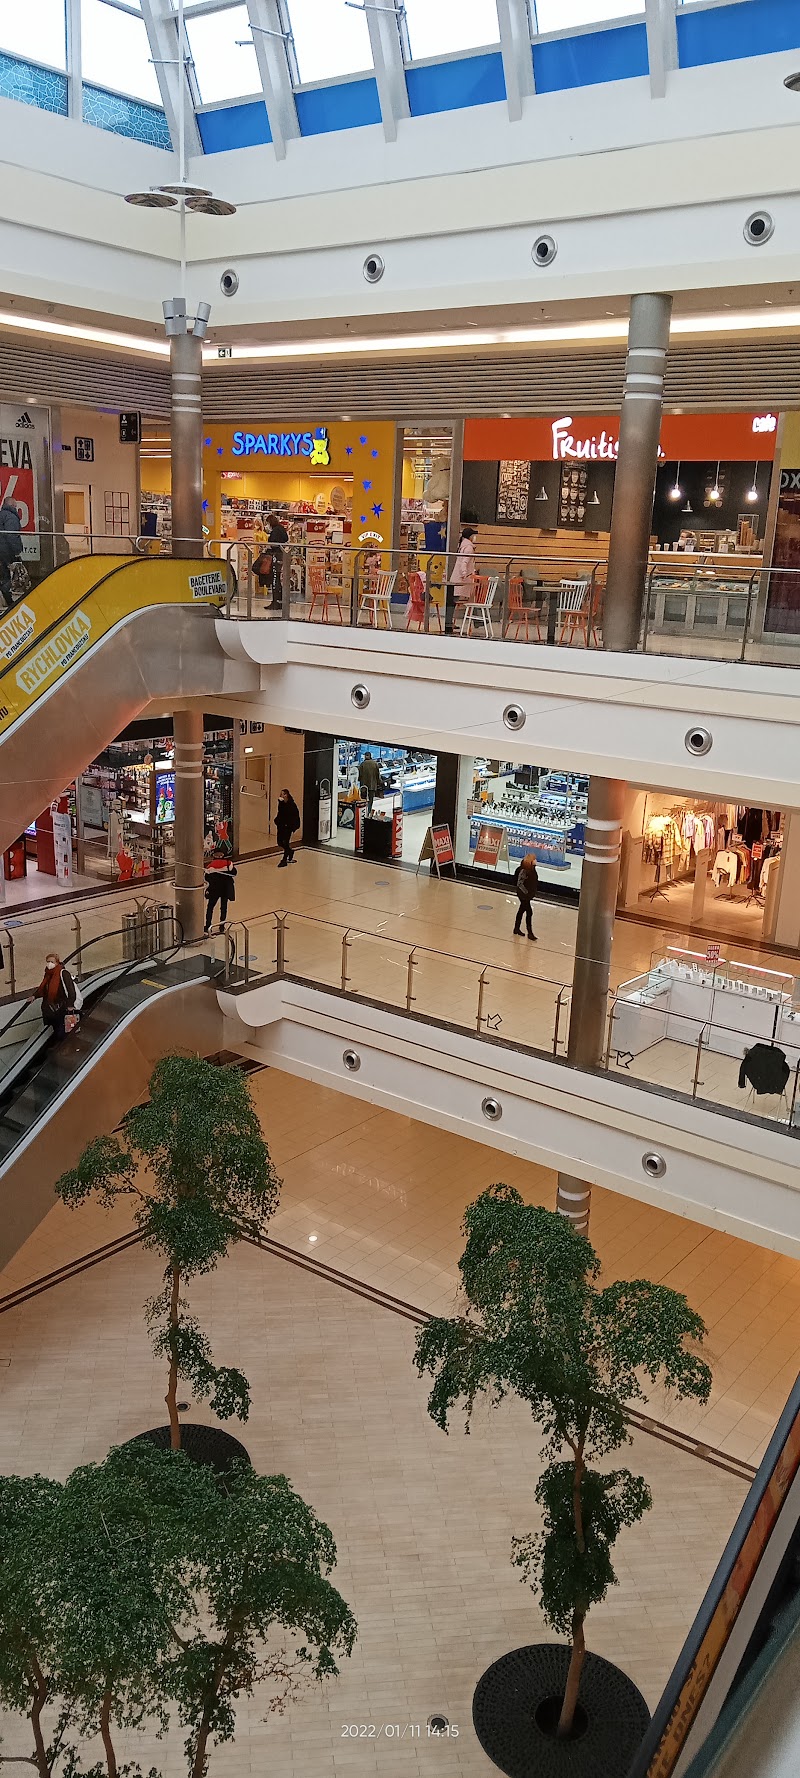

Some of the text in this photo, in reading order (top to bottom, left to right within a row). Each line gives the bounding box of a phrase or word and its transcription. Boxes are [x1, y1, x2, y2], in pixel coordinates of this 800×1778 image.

[15, 422, 35, 430] adidas
[232, 432, 313, 456] SPARKYS
[190, 572, 221, 588] BAGETERIE
[193, 583, 226, 597] BOULEVARD
[20, 616, 89, 690] RYCHLOVKA
[434, 836, 450, 847] MAXI
[479, 836, 500, 847] MAXI
